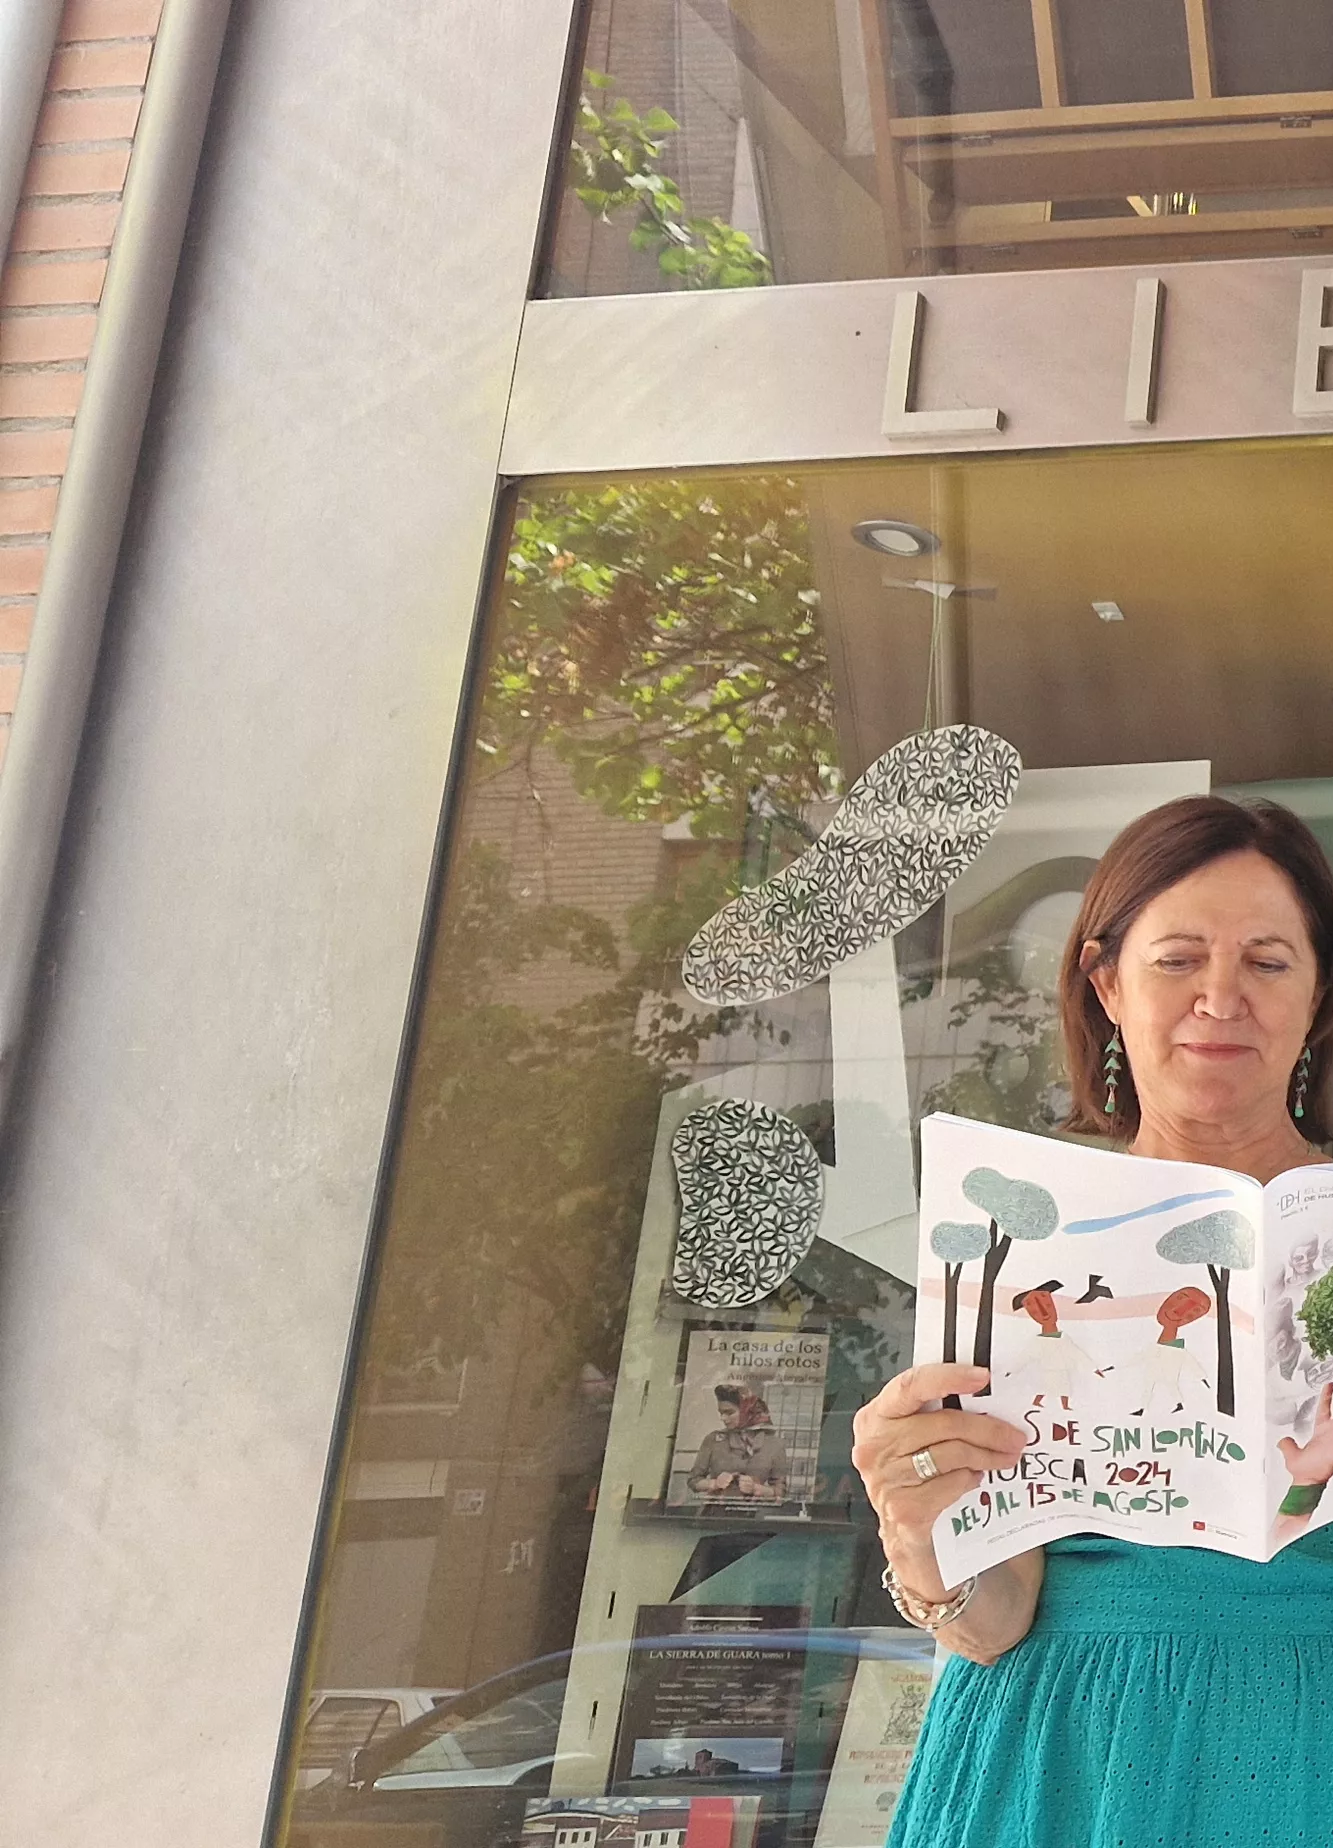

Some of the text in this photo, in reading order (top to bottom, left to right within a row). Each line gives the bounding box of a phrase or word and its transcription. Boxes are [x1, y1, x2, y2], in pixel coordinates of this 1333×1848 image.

[708, 1338, 822, 1354] La casa de los
[730, 1353, 821, 1369] hilos rotos
[1052, 1420, 1082, 1445] DE
[1090, 1425, 1141, 1458] SAN
[1151, 1421, 1246, 1463] LORENZO
[1105, 1460, 1172, 1487] 2024
[951, 1482, 1190, 1537] DEL 9 AL 15 DE AGOSTO
[666, 1651, 704, 1659] SIERRA
[706, 1651, 720, 1659] DE
[723, 1651, 760, 1659] GUARA
